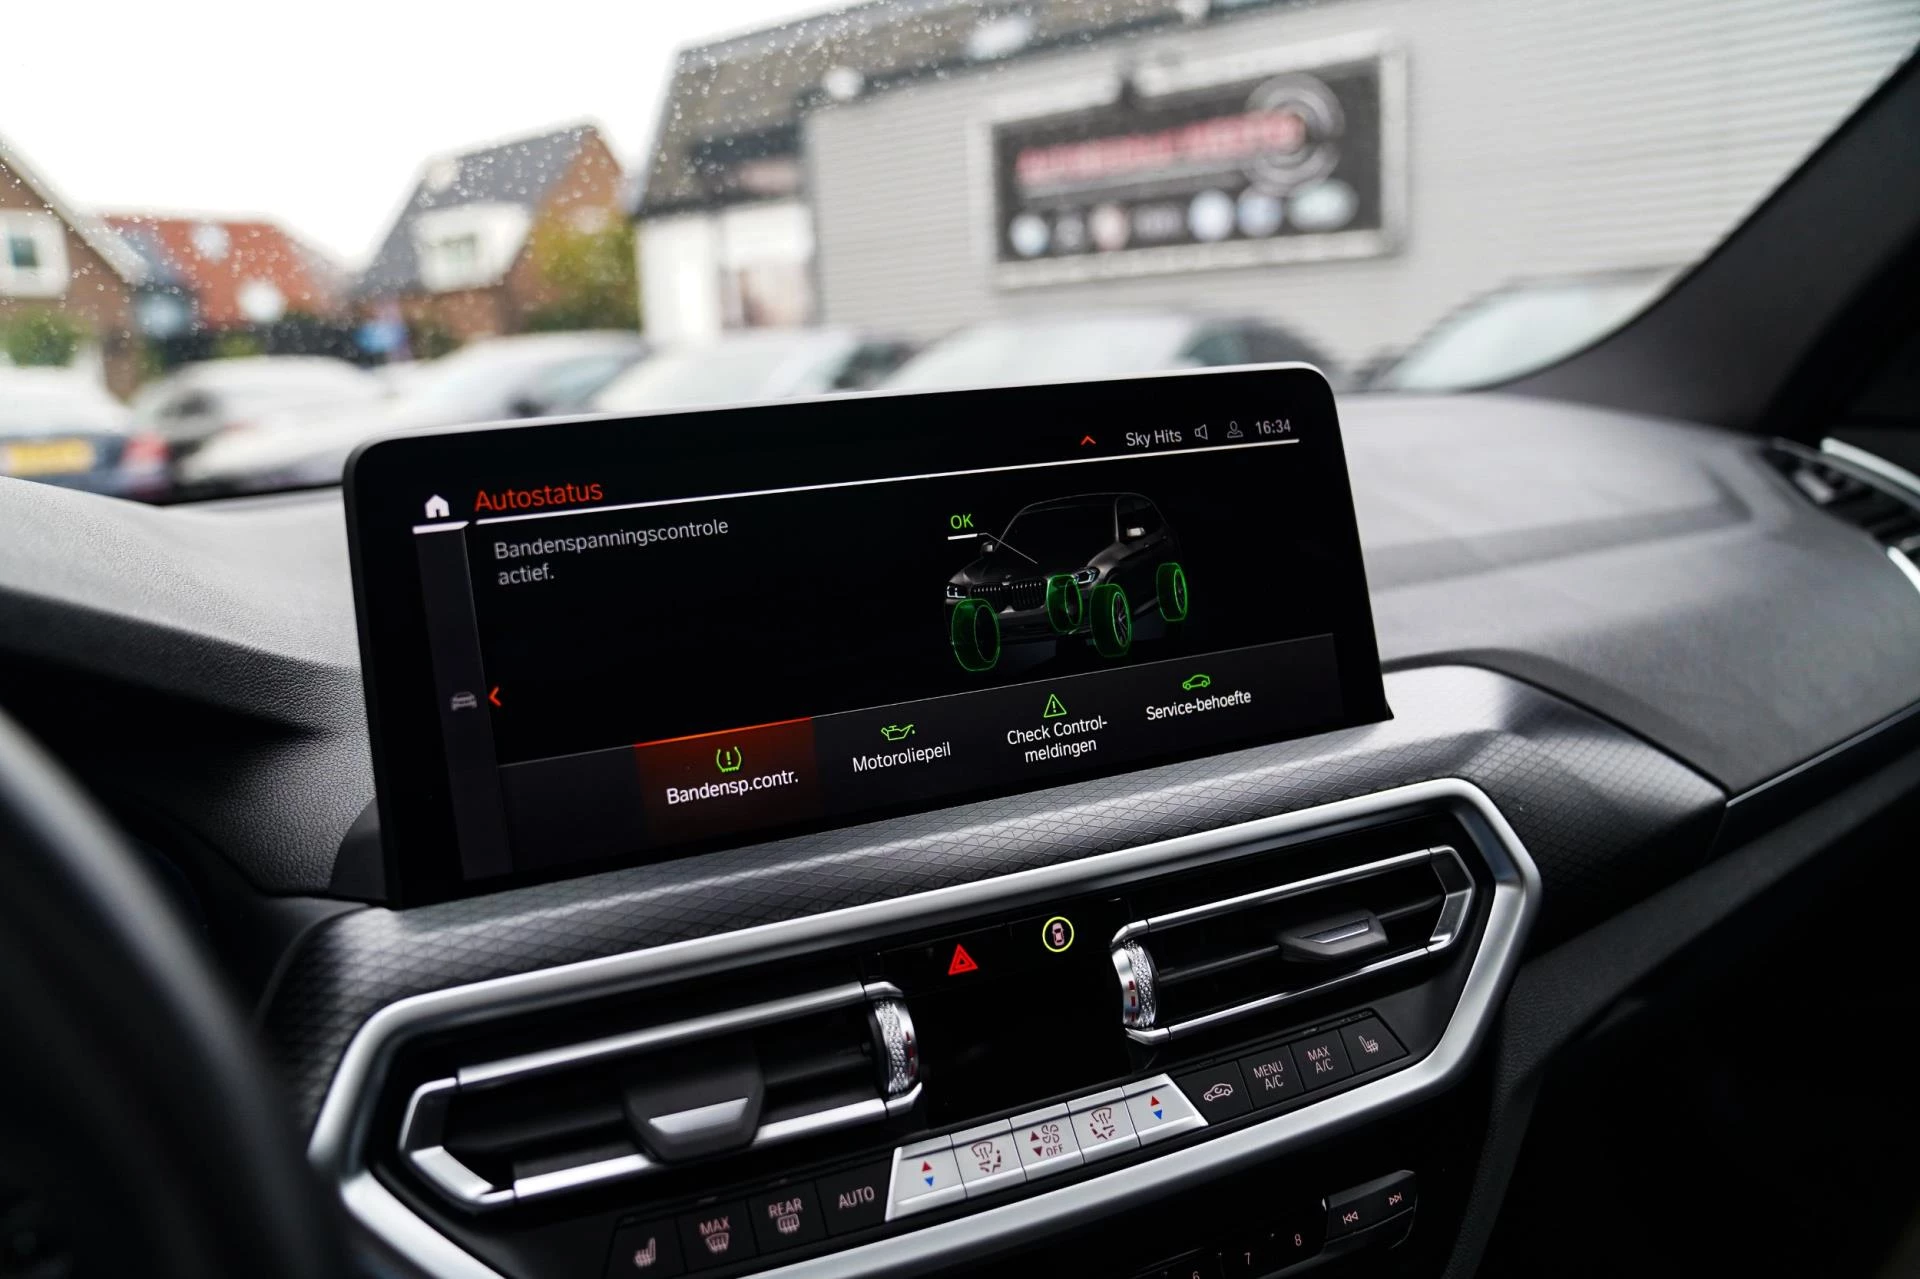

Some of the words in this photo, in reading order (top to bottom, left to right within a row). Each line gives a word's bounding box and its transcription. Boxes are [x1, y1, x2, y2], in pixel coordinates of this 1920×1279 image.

[1255, 419, 1291, 435] 16:34
[1126, 430, 1151, 448] Sky
[1155, 428, 1182, 445] Hits
[474, 482, 603, 511] Autostatus
[950, 514, 974, 530] OK
[495, 519, 729, 559] Bandenspanningscontrole
[499, 563, 555, 586] actief.
[1146, 690, 1252, 720] Service-behoefte
[1008, 726, 1050, 745] Check
[1053, 716, 1108, 738] Control-
[852, 742, 951, 772] Motoroliepeil
[1025, 738, 1097, 763] meldingen
[666, 770, 799, 804] Bandensp.contr.
[1307, 1046, 1330, 1061] MAX
[1254, 1061, 1283, 1078] MENU
[1315, 1058, 1333, 1072] A/C
[1265, 1074, 1284, 1090] A/C
[1046, 1143, 1063, 1156] OFF
[839, 1186, 875, 1208] AUTO
[768, 1198, 803, 1217] REAR
[700, 1216, 730, 1235] MAX
[1294, 1234, 1301, 1247] 8
[1244, 1252, 1250, 1265] 7
